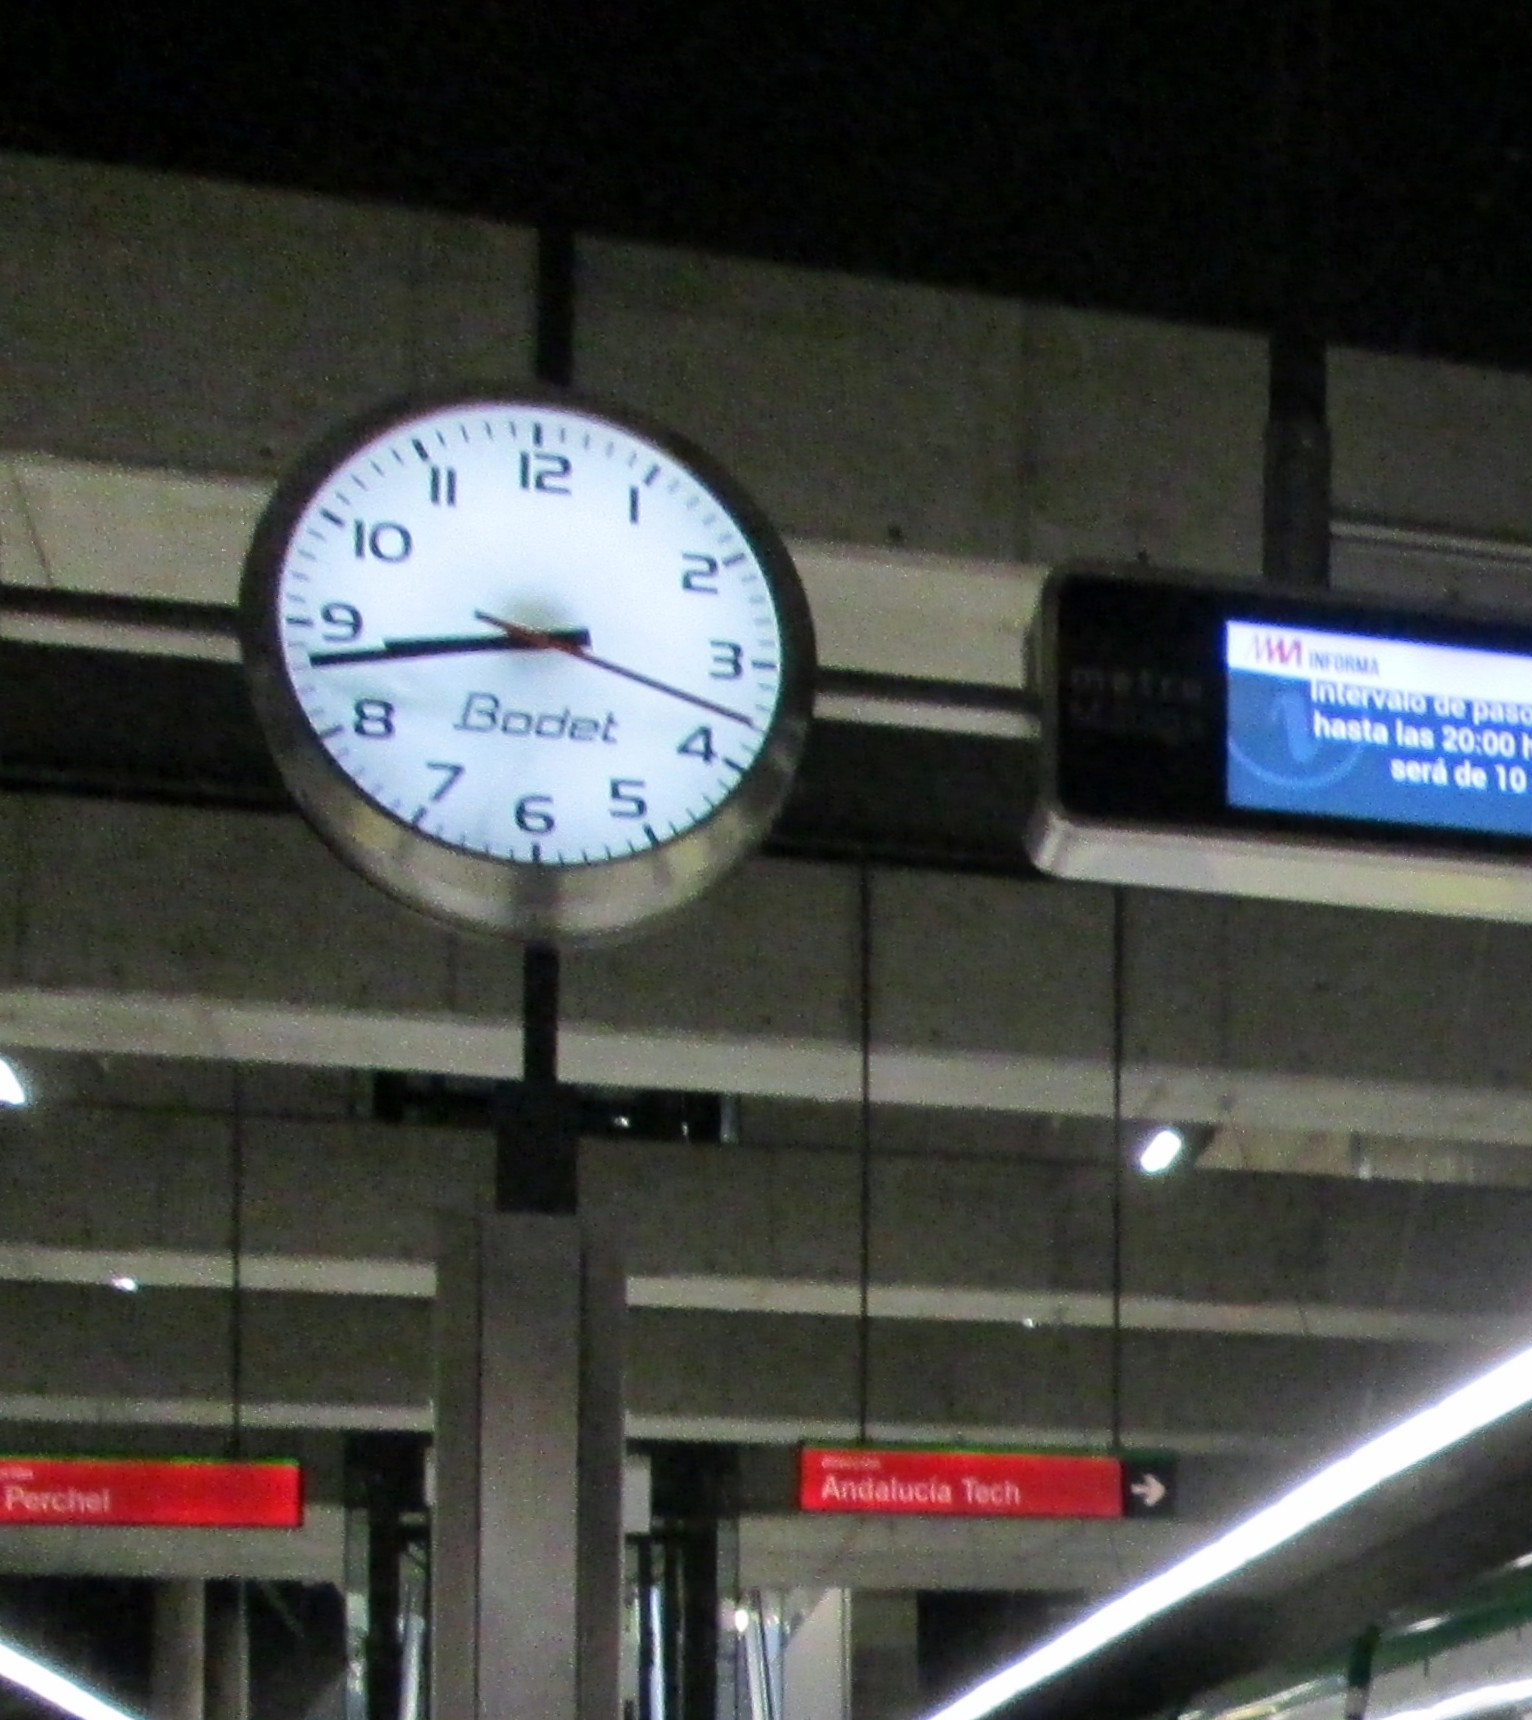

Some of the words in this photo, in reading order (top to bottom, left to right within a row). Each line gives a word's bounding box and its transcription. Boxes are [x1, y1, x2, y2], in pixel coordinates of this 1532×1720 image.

[431, 467, 456, 506] 11
[519, 453, 572, 495] 12
[629, 486, 639, 524] 1
[353, 520, 412, 562] 10
[682, 553, 718, 595] 2
[321, 604, 363, 643] 9
[709, 640, 744, 680] 3
[1309, 651, 1379, 676] INFORMA
[353, 699, 396, 740] 8
[453, 691, 619, 744] Bodet
[1434, 693, 1465, 720] de
[677, 727, 717, 763] 4
[1313, 709, 1388, 746] hasta
[1396, 717, 1433, 750] las
[1443, 724, 1515, 759] 20:00
[427, 763, 465, 801] 7
[1390, 756, 1448, 786] será
[1454, 758, 1487, 790] de
[1495, 764, 1526, 794] 10
[514, 796, 555, 834] 6
[610, 779, 647, 819] 5
[5, 1485, 110, 1513] Perchel
[961, 1476, 1021, 1506] Tech
